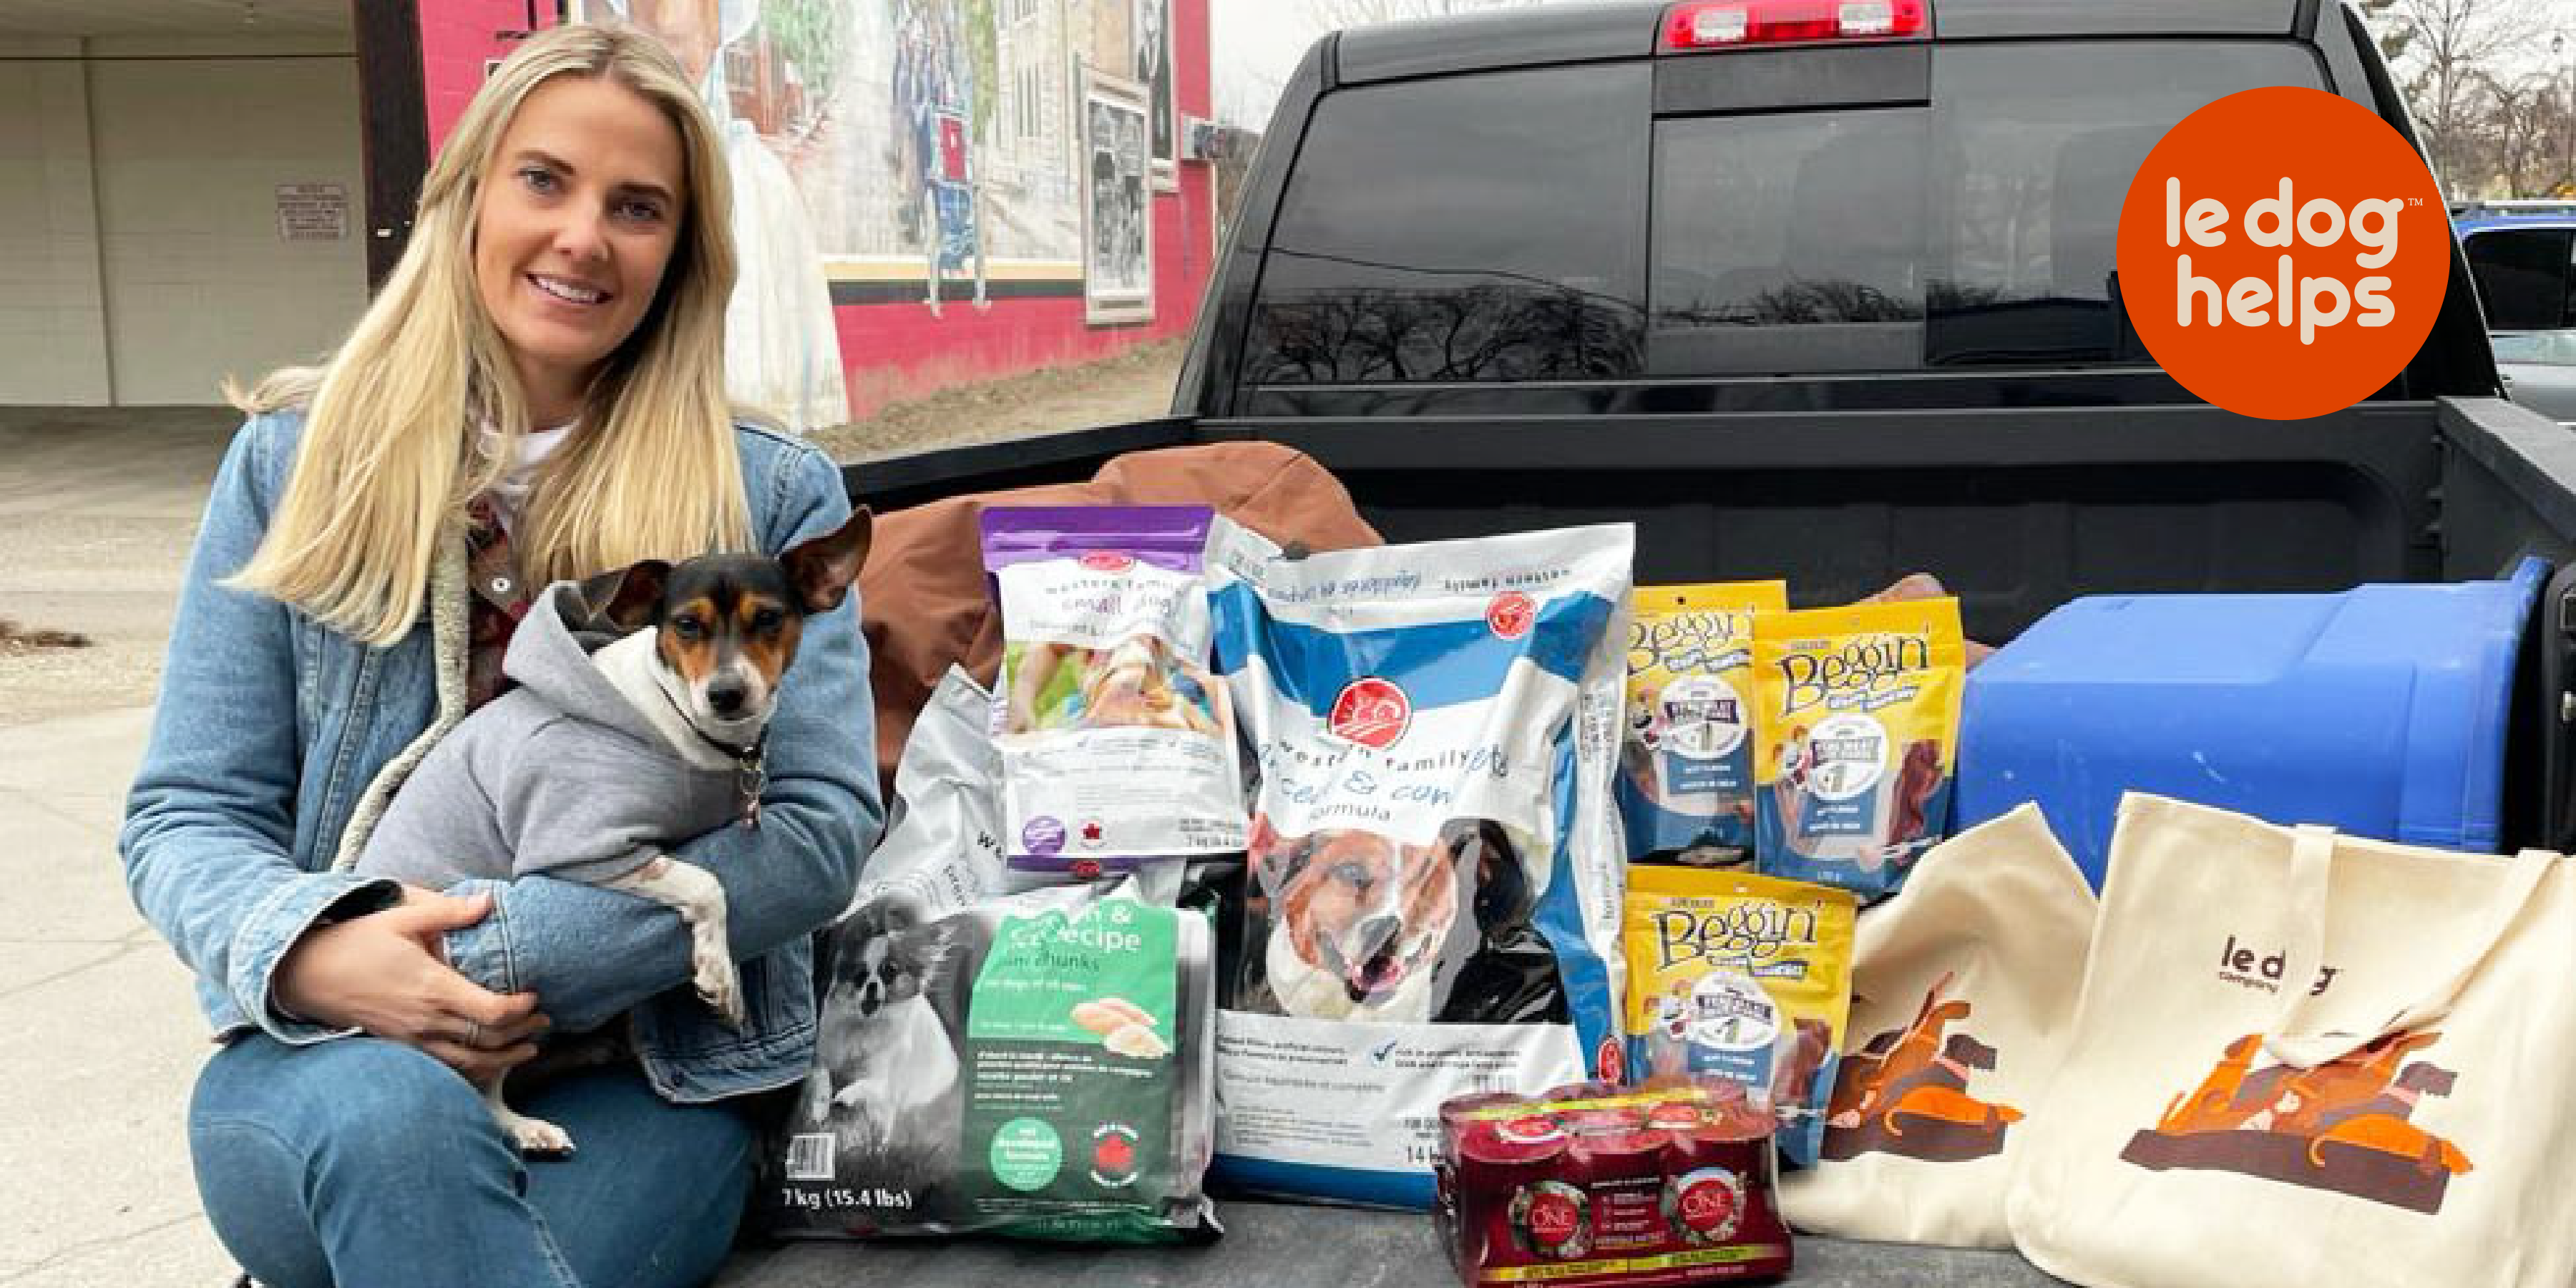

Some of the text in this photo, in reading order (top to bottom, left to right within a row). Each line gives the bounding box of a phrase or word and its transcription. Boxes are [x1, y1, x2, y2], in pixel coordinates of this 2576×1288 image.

[1776, 623, 1932, 717] Beggin'
[1652, 899, 1824, 972] Beggin'
[2221, 933, 2337, 997] le dg
[1406, 1144, 1425, 1163] 14
[781, 1188, 913, 1210] 7 kg (15.4 lbs)
[1684, 1191, 1732, 1214] ONE
[1531, 1204, 1571, 1226] ONE
